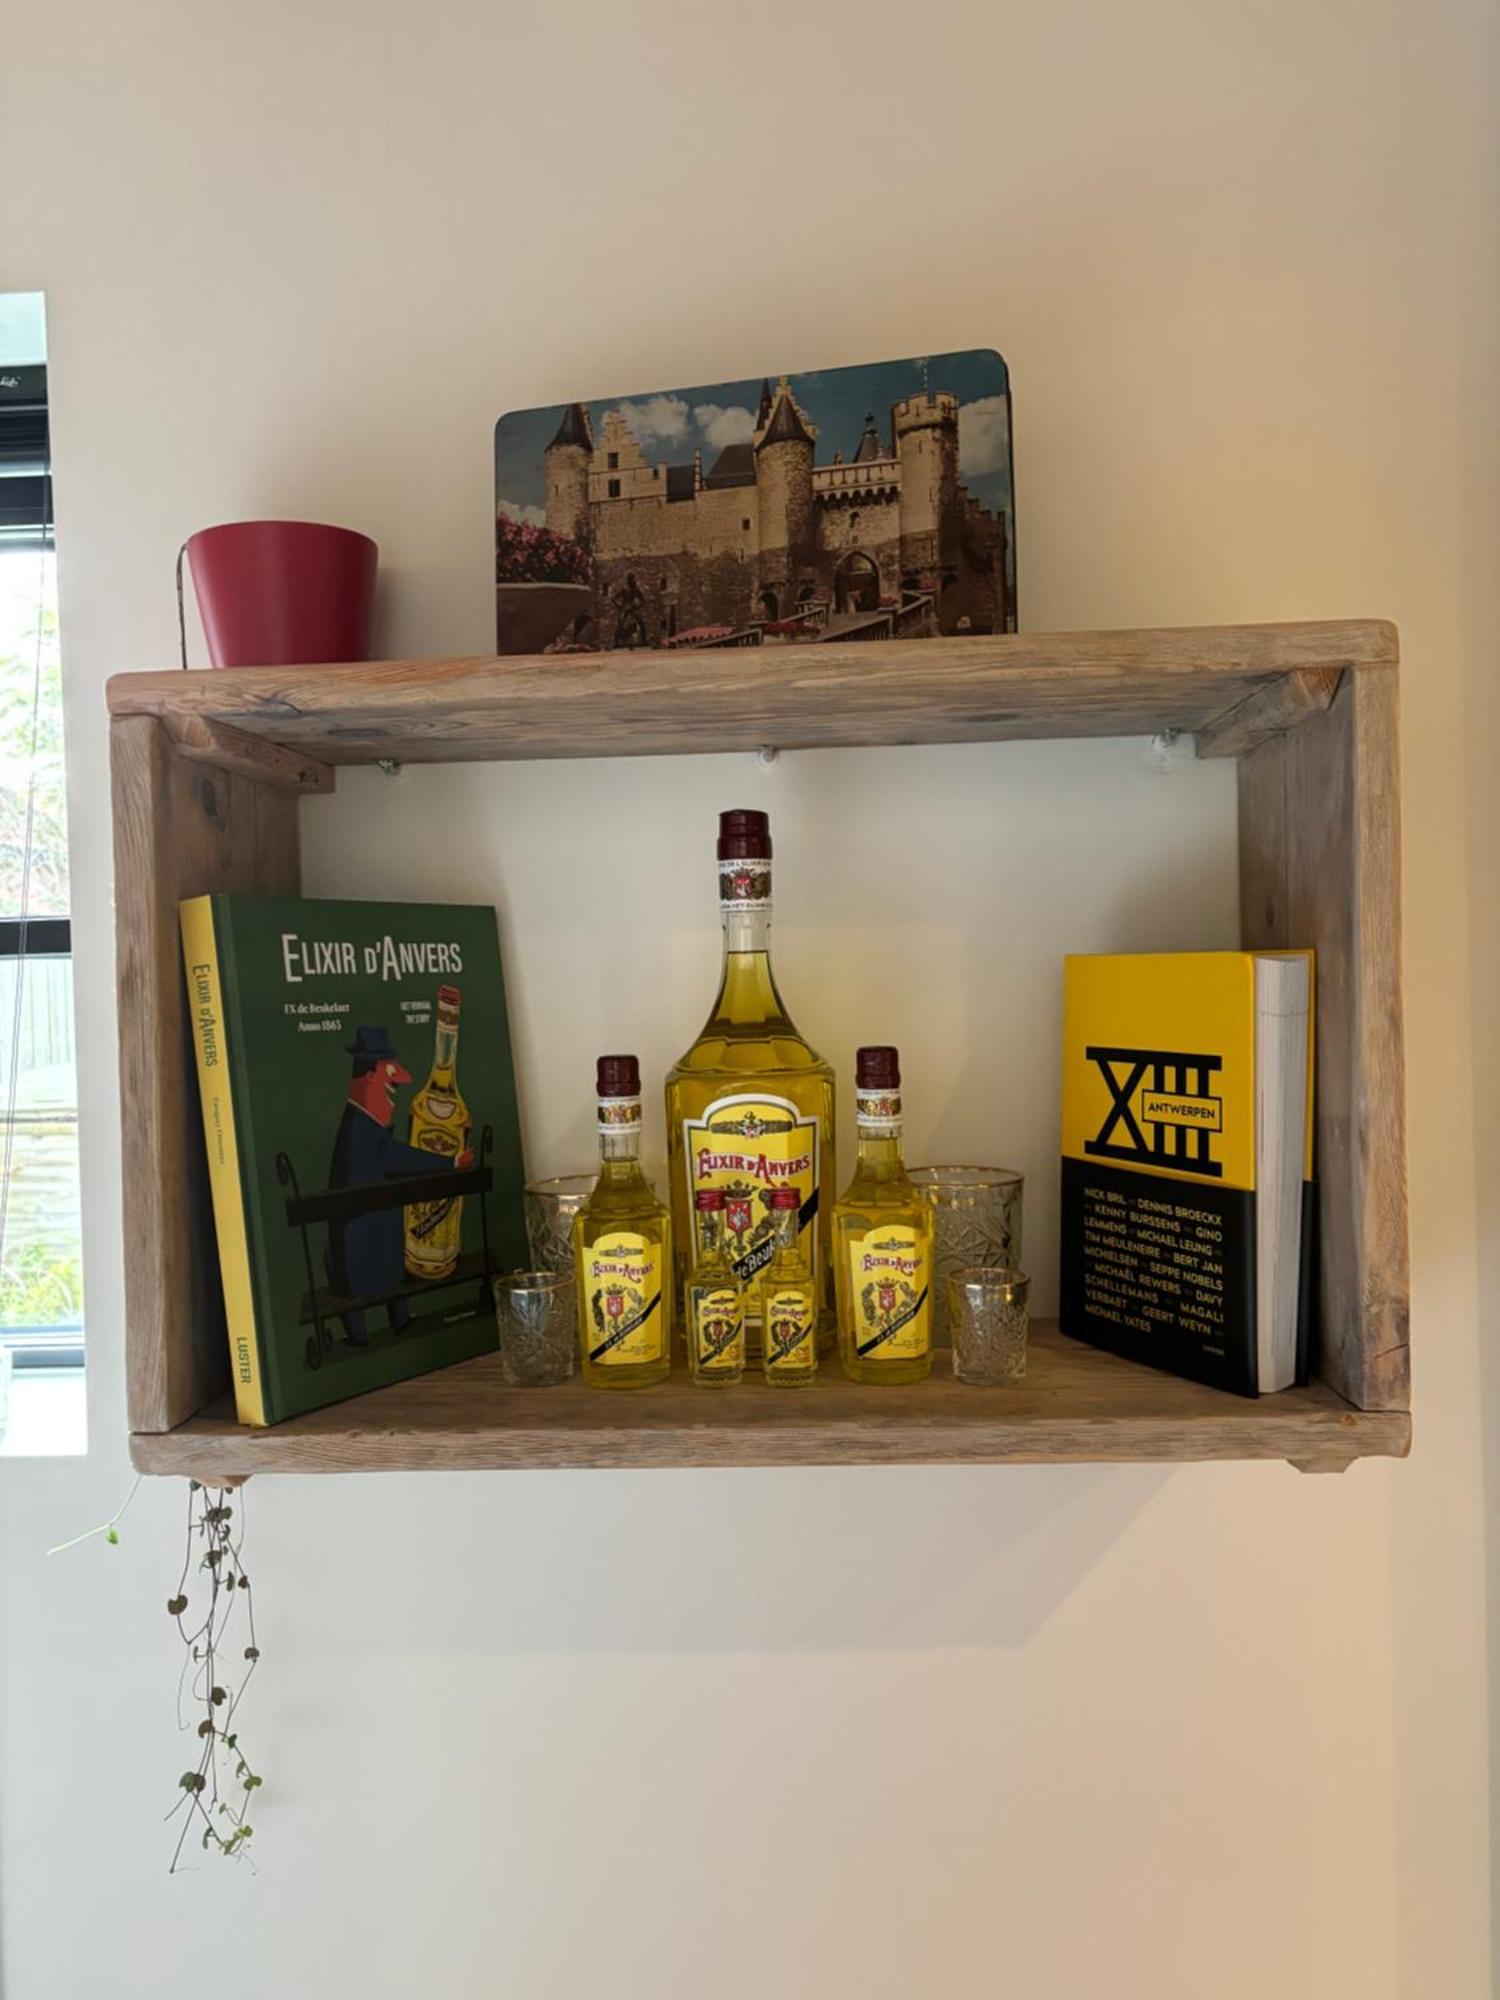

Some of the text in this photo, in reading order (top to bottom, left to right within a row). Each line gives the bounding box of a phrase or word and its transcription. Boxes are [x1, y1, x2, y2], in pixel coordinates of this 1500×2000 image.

[281, 933, 463, 982] ELIXIR D'ANVERS
[192, 963, 218, 1068] ELIXIR D'ANVERS
[1085, 1046, 1223, 1178] XIII
[1148, 1102, 1216, 1120] ANTWERPEN
[697, 1147, 810, 1188] ELIXIR D'ANVERS
[1084, 1187, 1105, 1200] NICK
[1137, 1197, 1173, 1216] DENNIS
[1175, 1205, 1222, 1226] BROECKX
[1094, 1203, 1222, 1242] KENNY BURSSENS GINO
[1084, 1215, 1127, 1235] LEMMENS
[1179, 1238, 1213, 1257] LEUNG
[1085, 1229, 1222, 1275] TIM MEULENEIRE BERT JAN
[1138, 1273, 1181, 1295] REWERS
[1195, 1288, 1223, 1308] DAVY
[1149, 1260, 1181, 1280] SEPPE
[1182, 1270, 1223, 1292] NOBELS
[1084, 1272, 1224, 1324] SCHELLEMANS MAGALI
[1124, 1314, 1152, 1333] YATES
[1141, 1304, 1175, 1324] GEERT
[1178, 1315, 1212, 1336] WEYN
[236, 1336, 252, 1384] LUSTER
